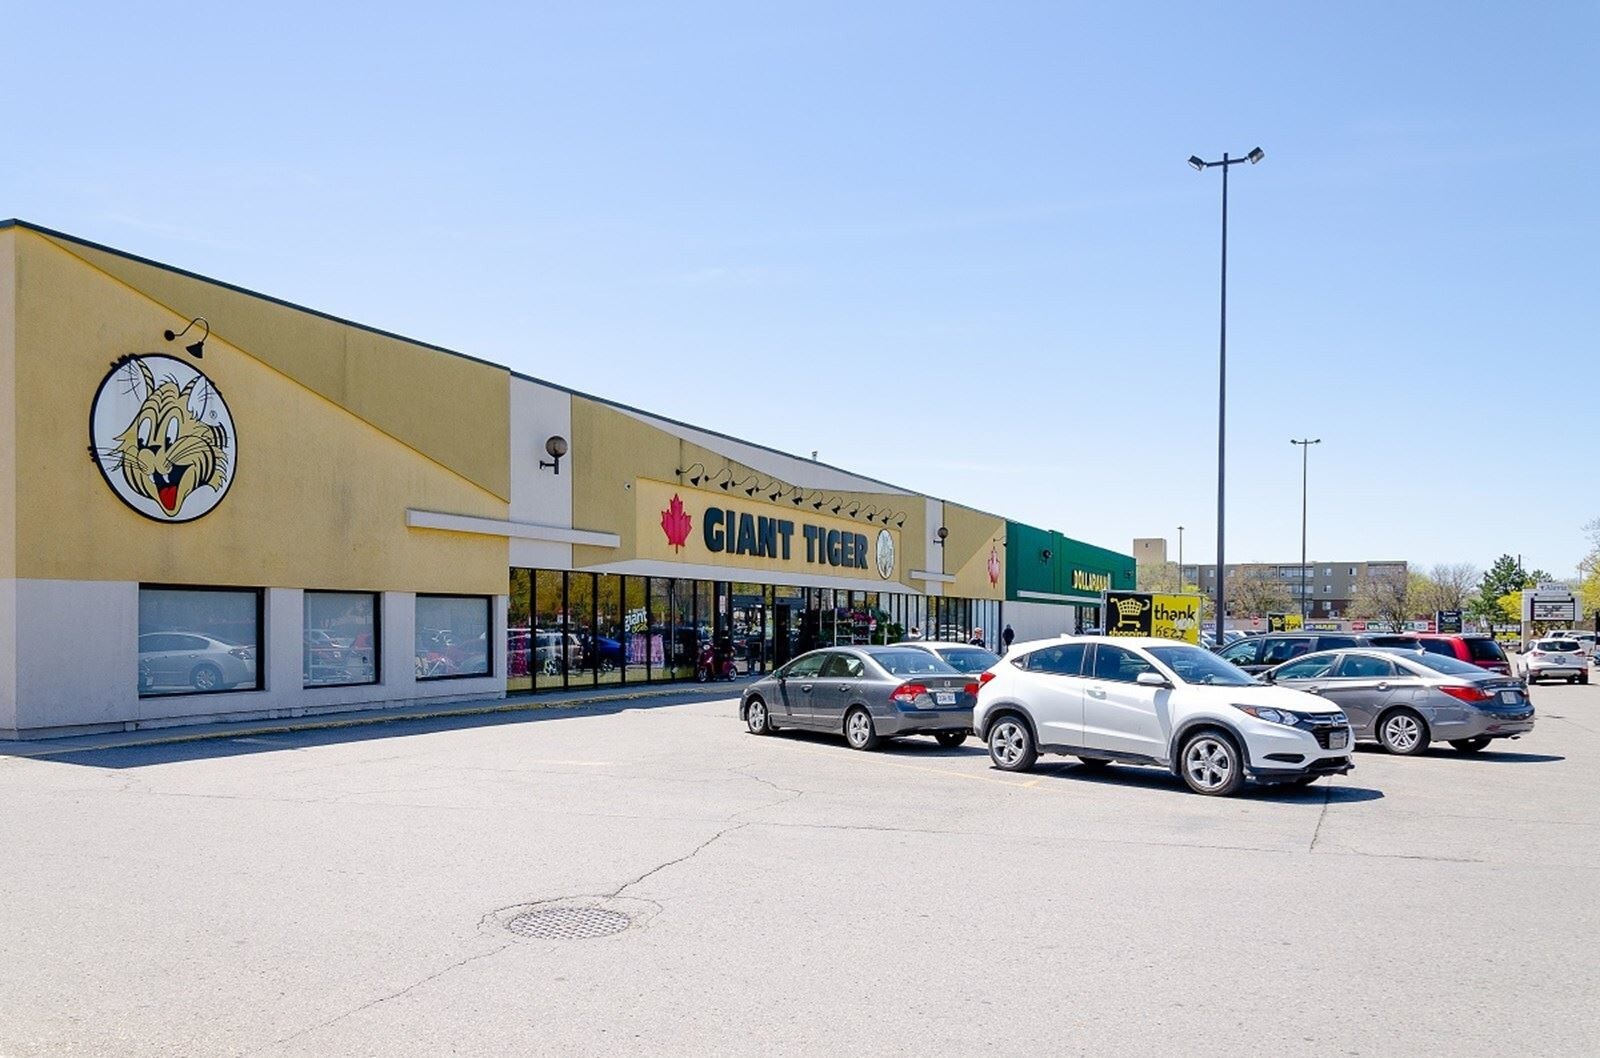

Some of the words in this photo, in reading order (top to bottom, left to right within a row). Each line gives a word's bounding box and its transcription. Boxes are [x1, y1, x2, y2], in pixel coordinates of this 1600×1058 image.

[703, 507, 794, 560] GIANT
[803, 523, 869, 569] TIGER
[1154, 603, 1196, 621] thank
